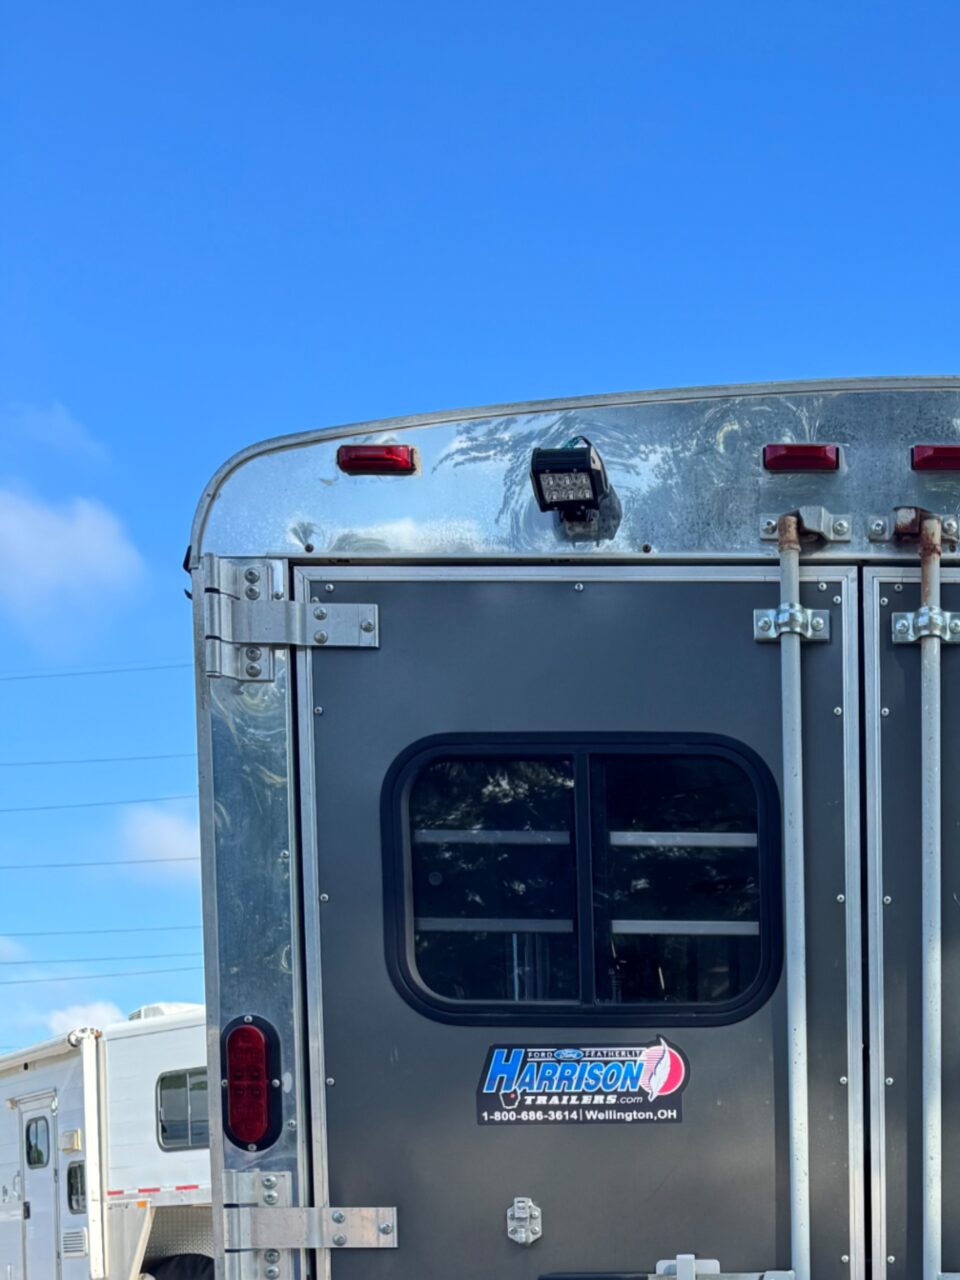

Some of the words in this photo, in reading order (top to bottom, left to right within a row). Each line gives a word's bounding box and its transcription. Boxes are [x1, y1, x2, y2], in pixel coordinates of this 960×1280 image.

[585, 1050, 641, 1058] FEATHERLIT
[483, 1049, 644, 1093] HARRISON
[524, 1095, 643, 1105] TRAILERS.com
[482, 1110, 578, 1121] 1-800-686-3614
[585, 1109, 677, 1121] Wellington,OH
